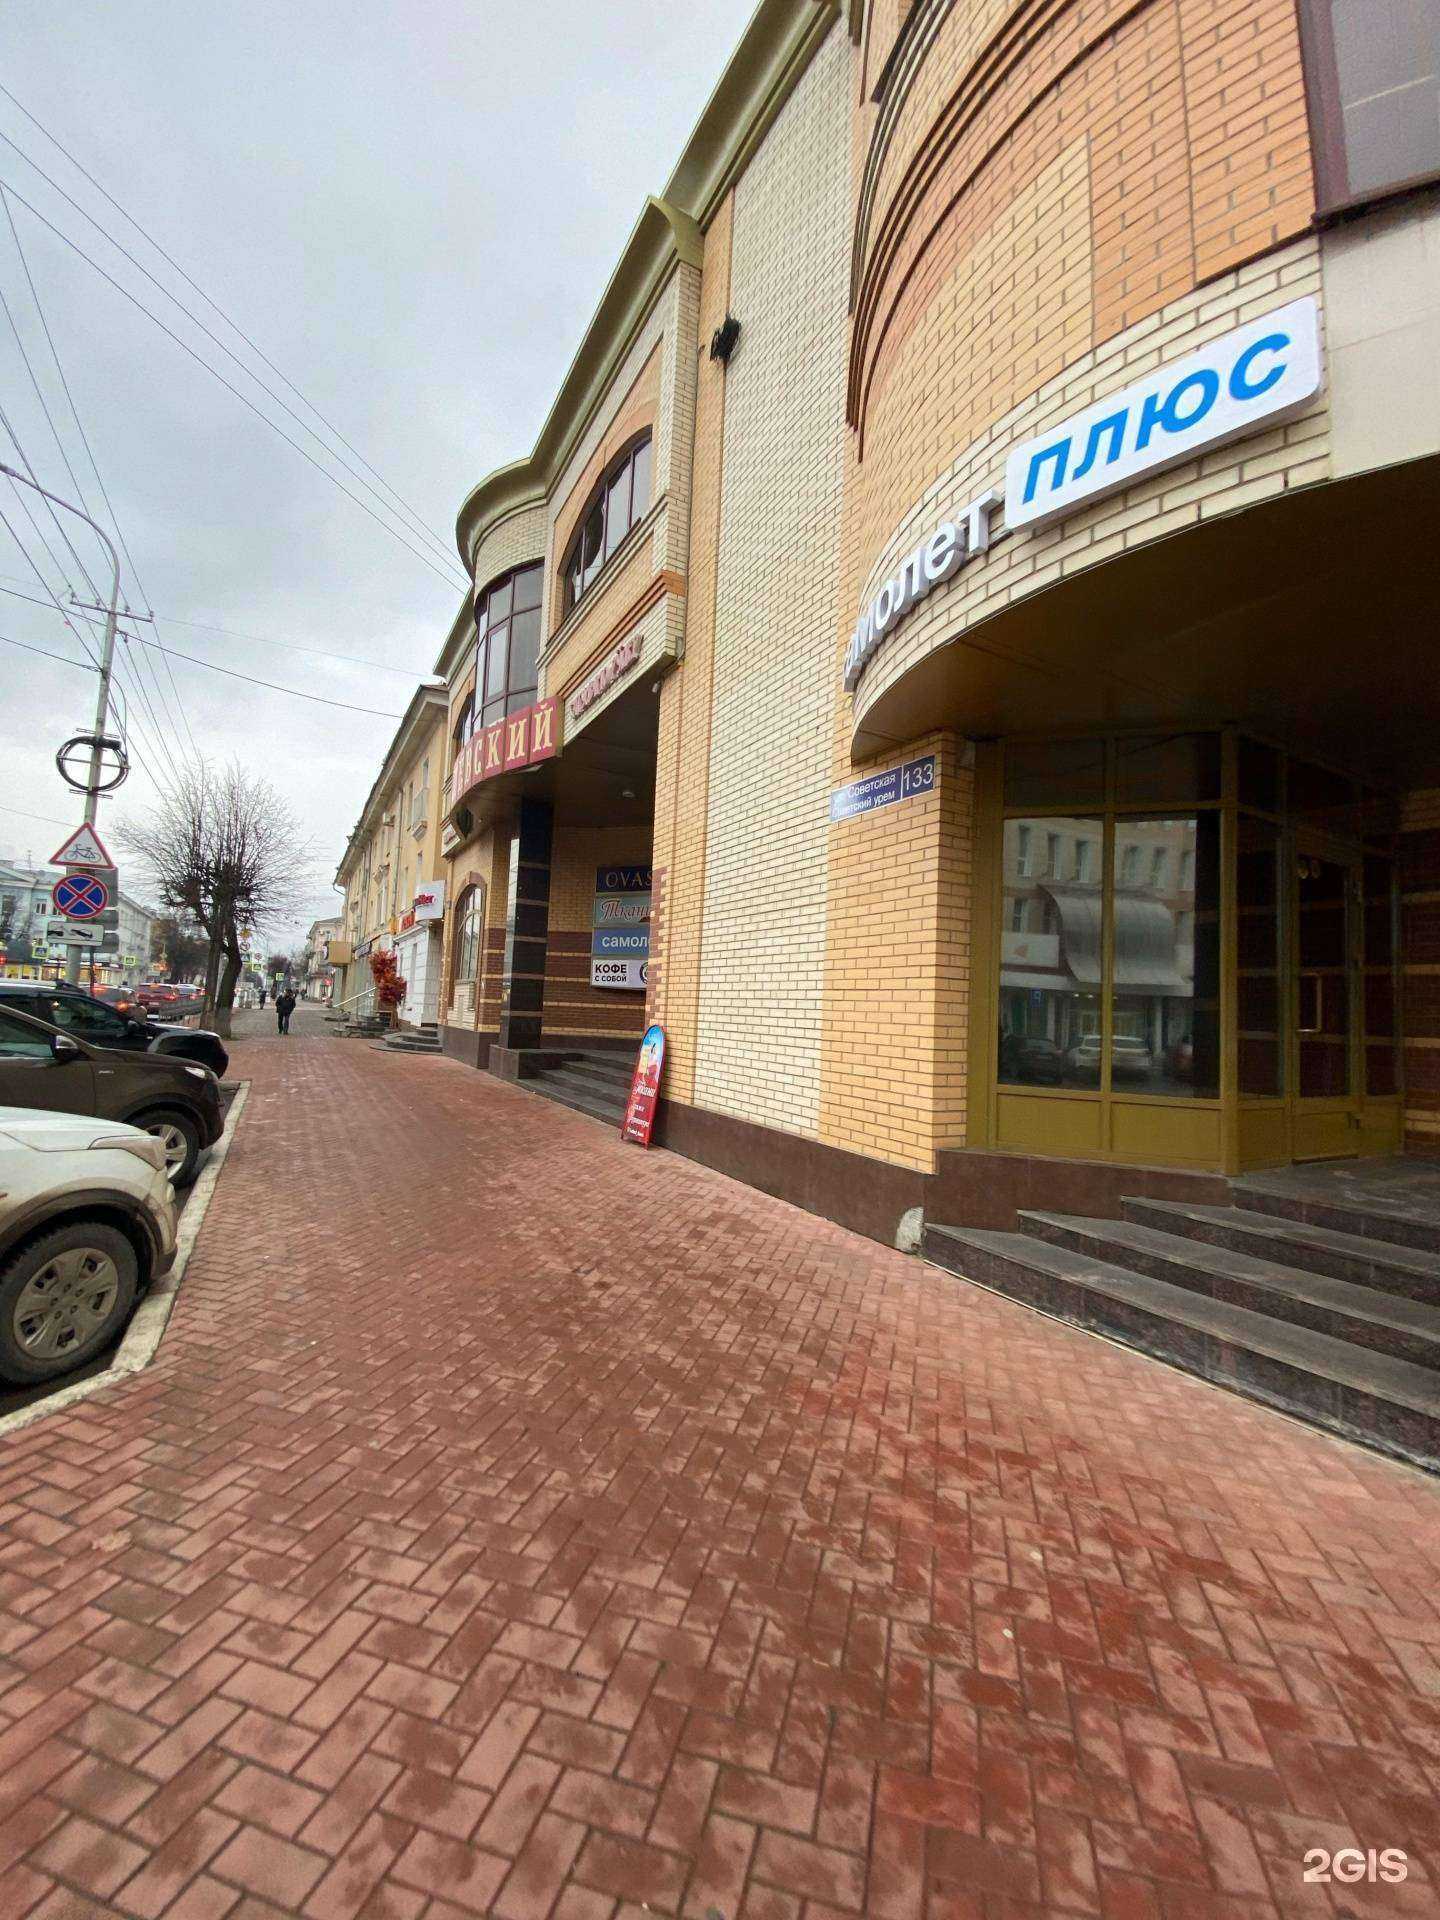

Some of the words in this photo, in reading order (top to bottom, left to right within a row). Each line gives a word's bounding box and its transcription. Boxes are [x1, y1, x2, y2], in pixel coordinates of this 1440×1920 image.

[843, 489, 1001, 692] амолет
[848, 774, 896, 798] Советская
[904, 764, 934, 791] 133
[874, 791, 895, 807] урем
[595, 964, 627, 974] КОФЕ
